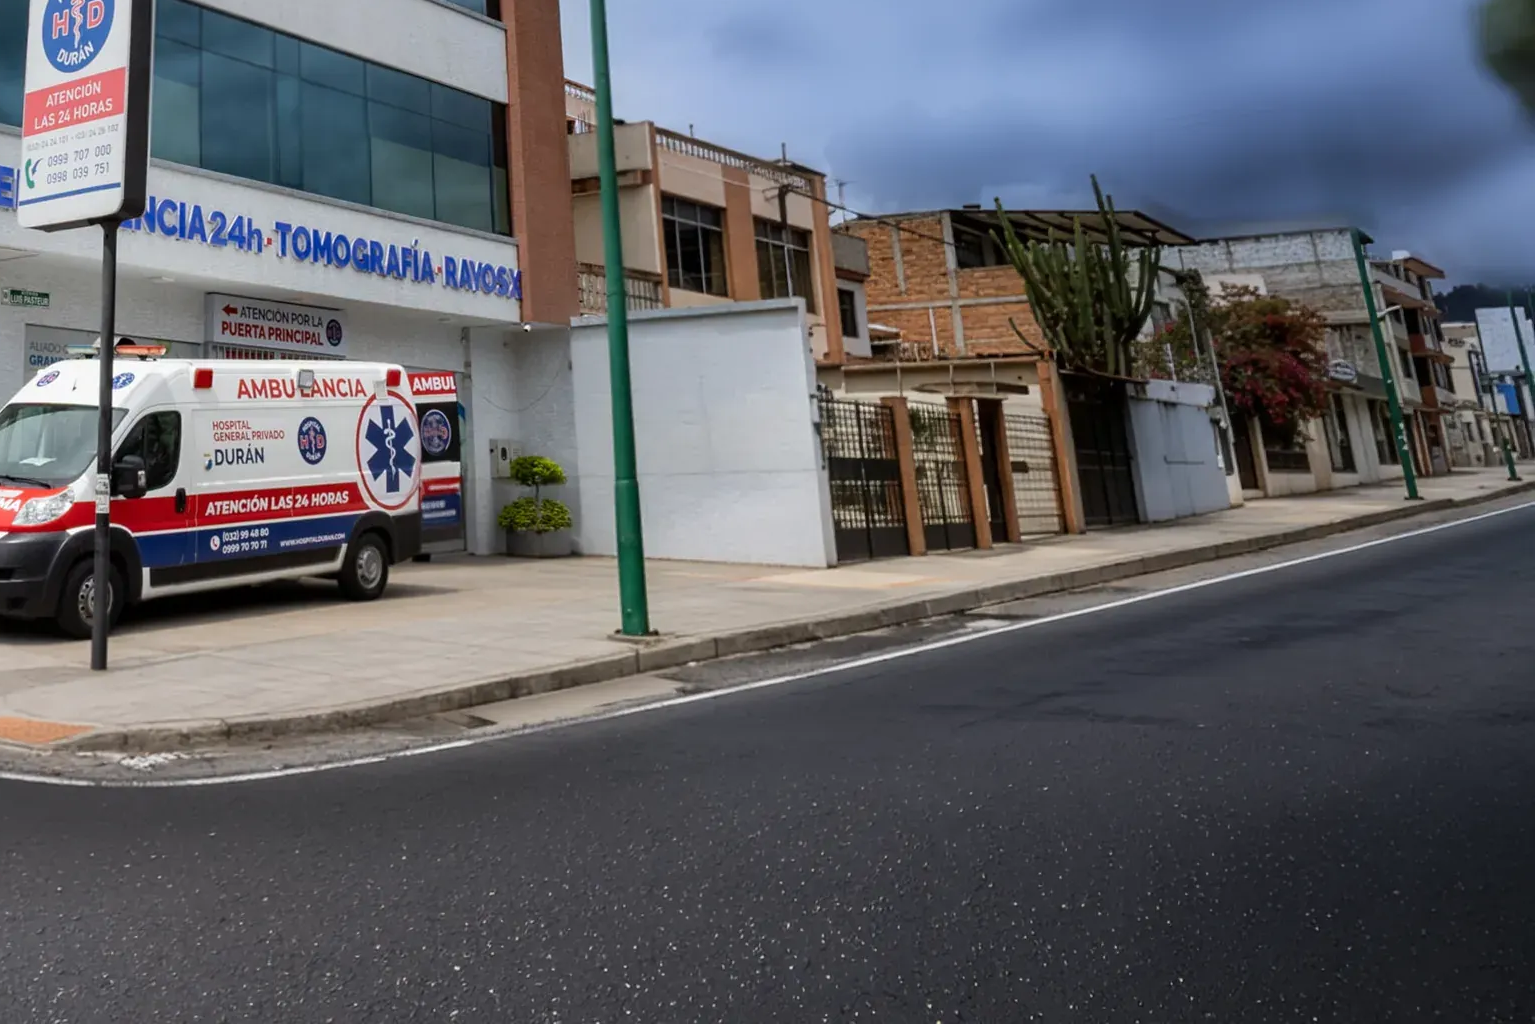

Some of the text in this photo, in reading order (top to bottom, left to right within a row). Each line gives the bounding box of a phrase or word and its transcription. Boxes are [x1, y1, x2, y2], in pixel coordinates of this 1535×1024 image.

[56, 40, 94, 66] DURÁN
[45, 80, 102, 108] ATENCIÓN
[34, 97, 114, 130] LAS 24 HORAS
[47, 144, 112, 167] 0999 707 000
[46, 162, 110, 184] 0998 039 751
[274, 220, 435, 284] TOMOGRAFÍA
[239, 306, 324, 329] ATENCIÓN POR LA
[221, 320, 267, 340] PUERTA
[268, 326, 325, 346] PRINCIPAL
[237, 378, 367, 399] AMBULANCIA
[212, 420, 252, 431] HOSPITAL
[213, 430, 285, 442] GENERAL PRIVADO
[214, 443, 265, 466] DURÁN
[205, 491, 350, 516] ATENCIÓN LAS 24 HORAS
[240, 530, 249, 539] 99
[250, 529, 259, 538] 48
[222, 543, 240, 554] 0999
[241, 542, 250, 551] 70
[250, 541, 260, 550] 70
